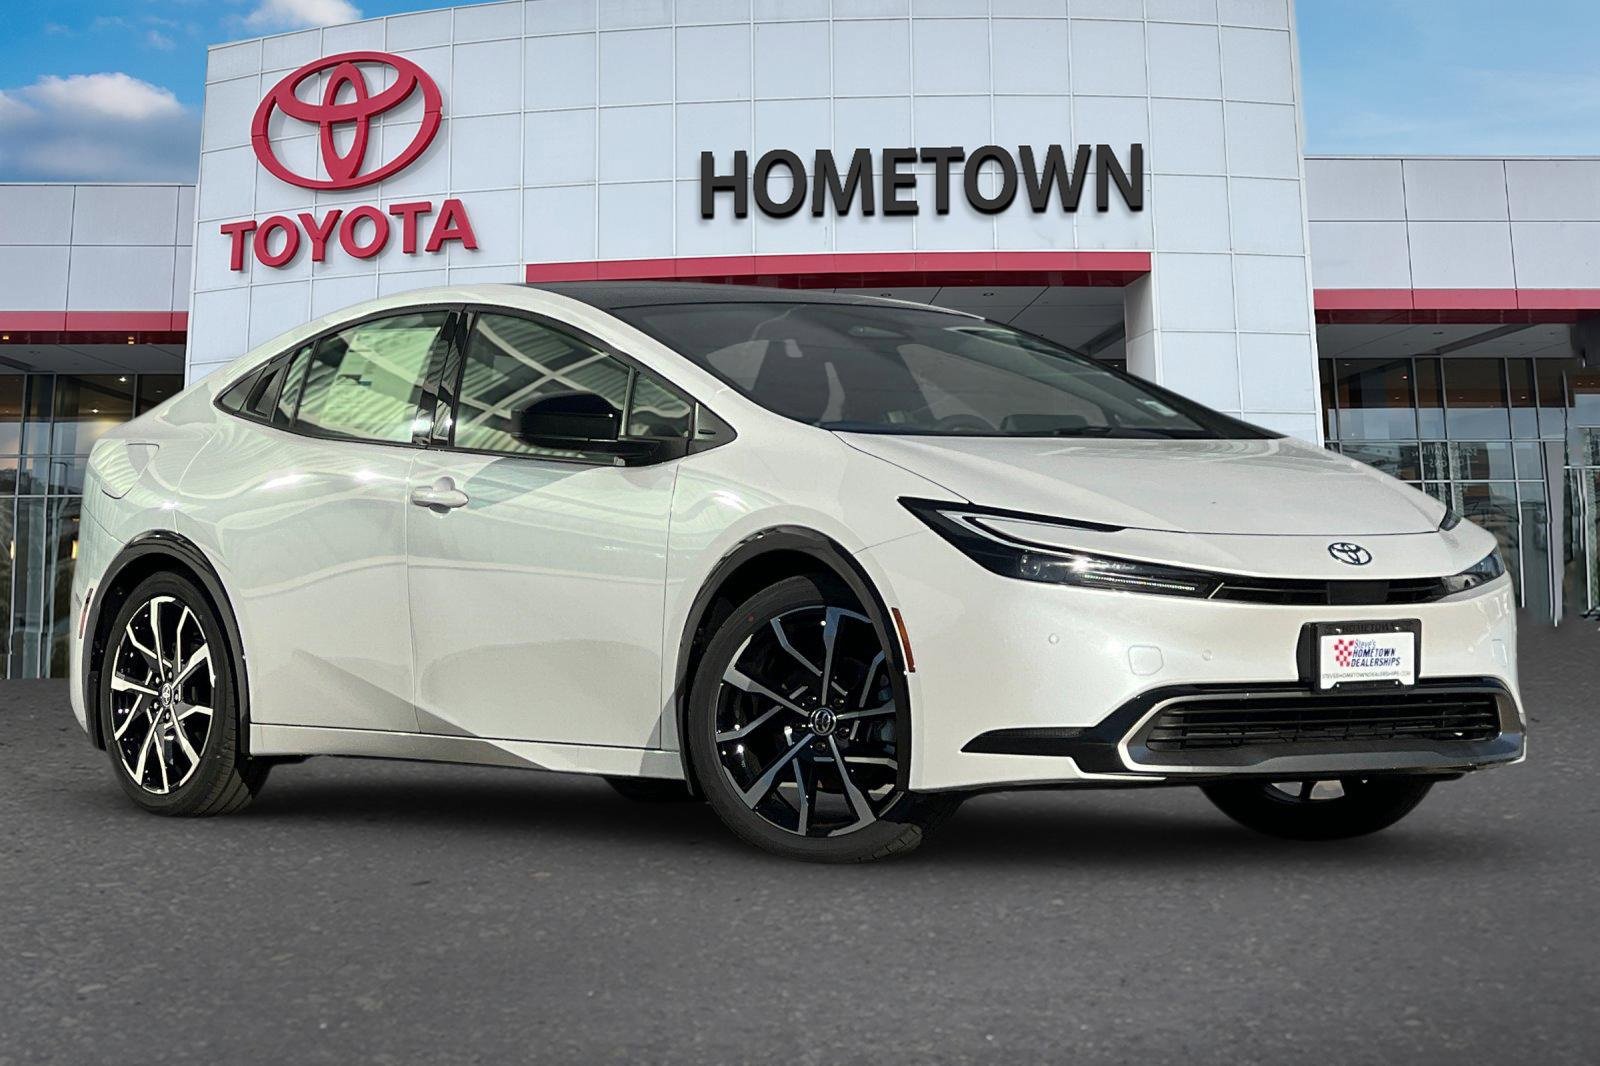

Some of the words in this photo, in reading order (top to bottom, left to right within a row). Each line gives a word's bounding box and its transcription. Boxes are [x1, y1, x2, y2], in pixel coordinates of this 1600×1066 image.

[700, 143, 1143, 219] HOMETOWN
[220, 198, 479, 271] TOYOTA
[1355, 639, 1376, 649] Steve's
[1353, 648, 1396, 658] HOMETOWN
[1351, 657, 1401, 667] DEALERSHIPS
